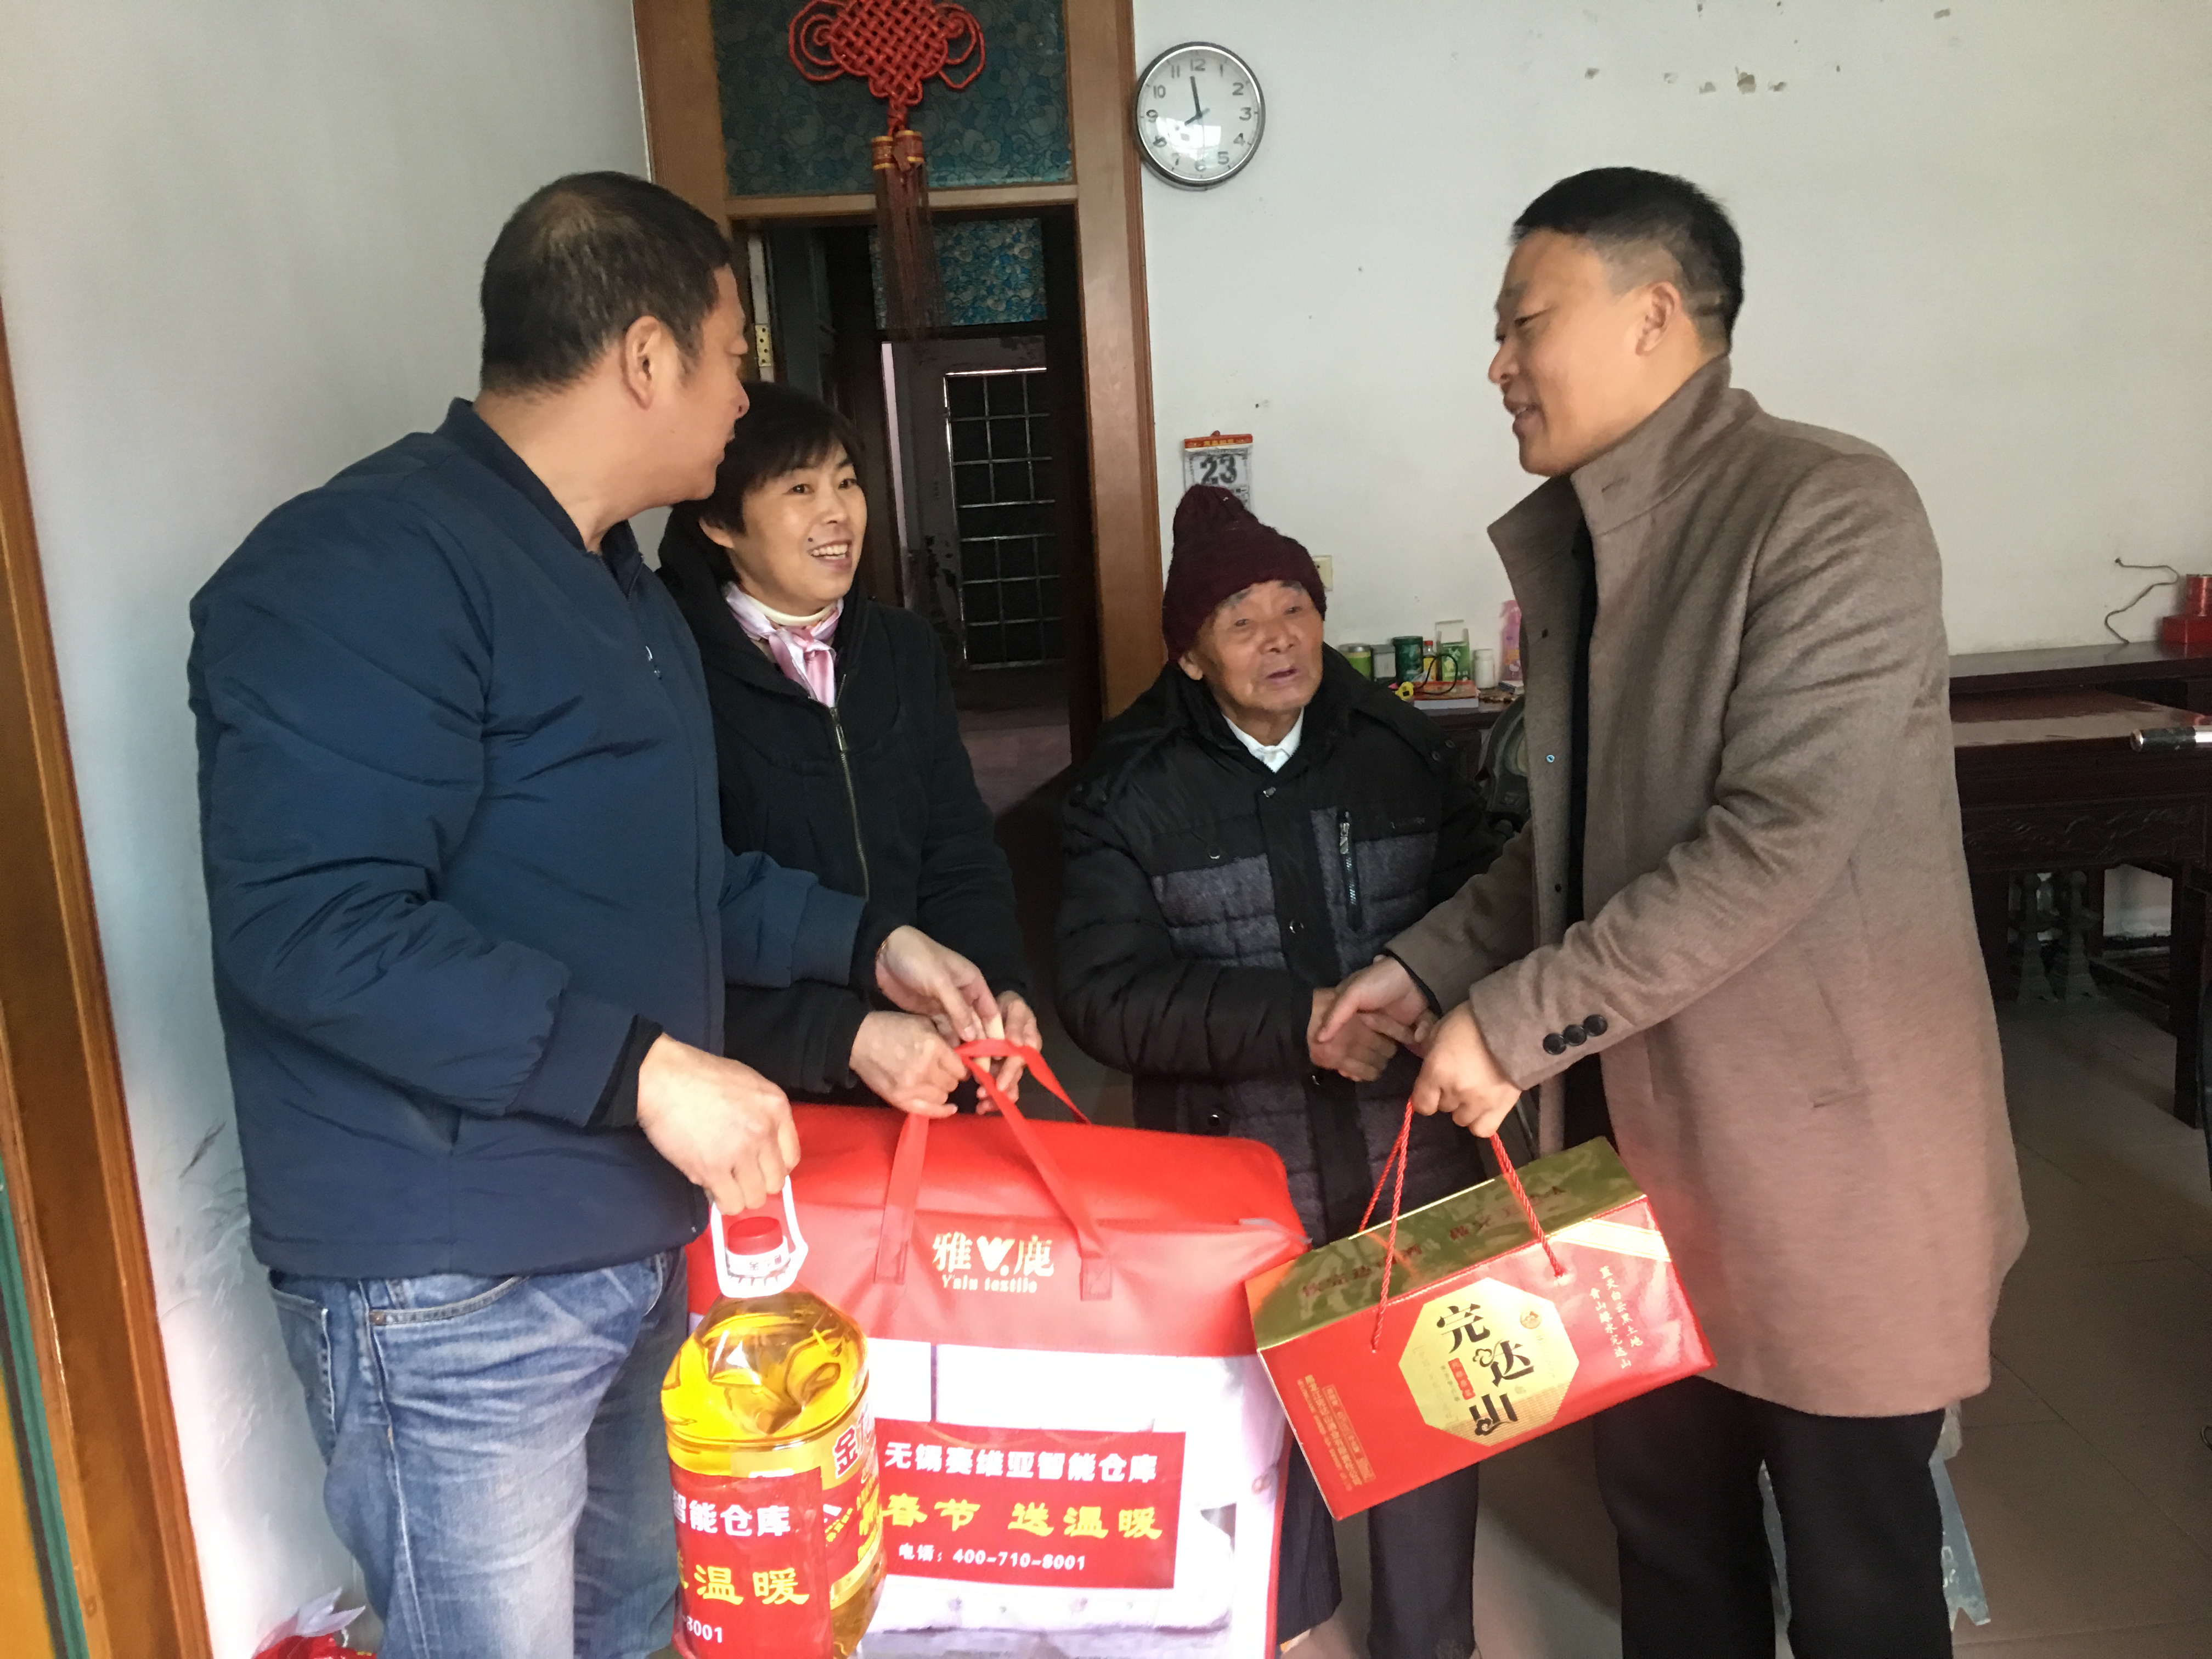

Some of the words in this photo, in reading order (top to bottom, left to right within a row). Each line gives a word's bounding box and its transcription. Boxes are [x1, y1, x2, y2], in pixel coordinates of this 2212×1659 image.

[1171, 65, 1180, 78] 11
[1190, 59, 1206, 72] 12
[1220, 64, 1223, 77] 1
[1153, 84, 1166, 98] 10
[1232, 83, 1244, 96] 2
[1146, 109, 1158, 122] 9
[1239, 107, 1252, 121] 3
[1233, 133, 1245, 144] 4
[1217, 151, 1229, 165] 5
[1200, 454, 1237, 484] 23
[1436, 1304, 1534, 1436] 完达山
[884, 1441, 1158, 1483] 无锡赛维亚智能仓库
[881, 1493, 980, 1532] 春节
[1008, 1502, 1163, 1540] 送温暖
[952, 1548, 1085, 1571] 400-710-8001
